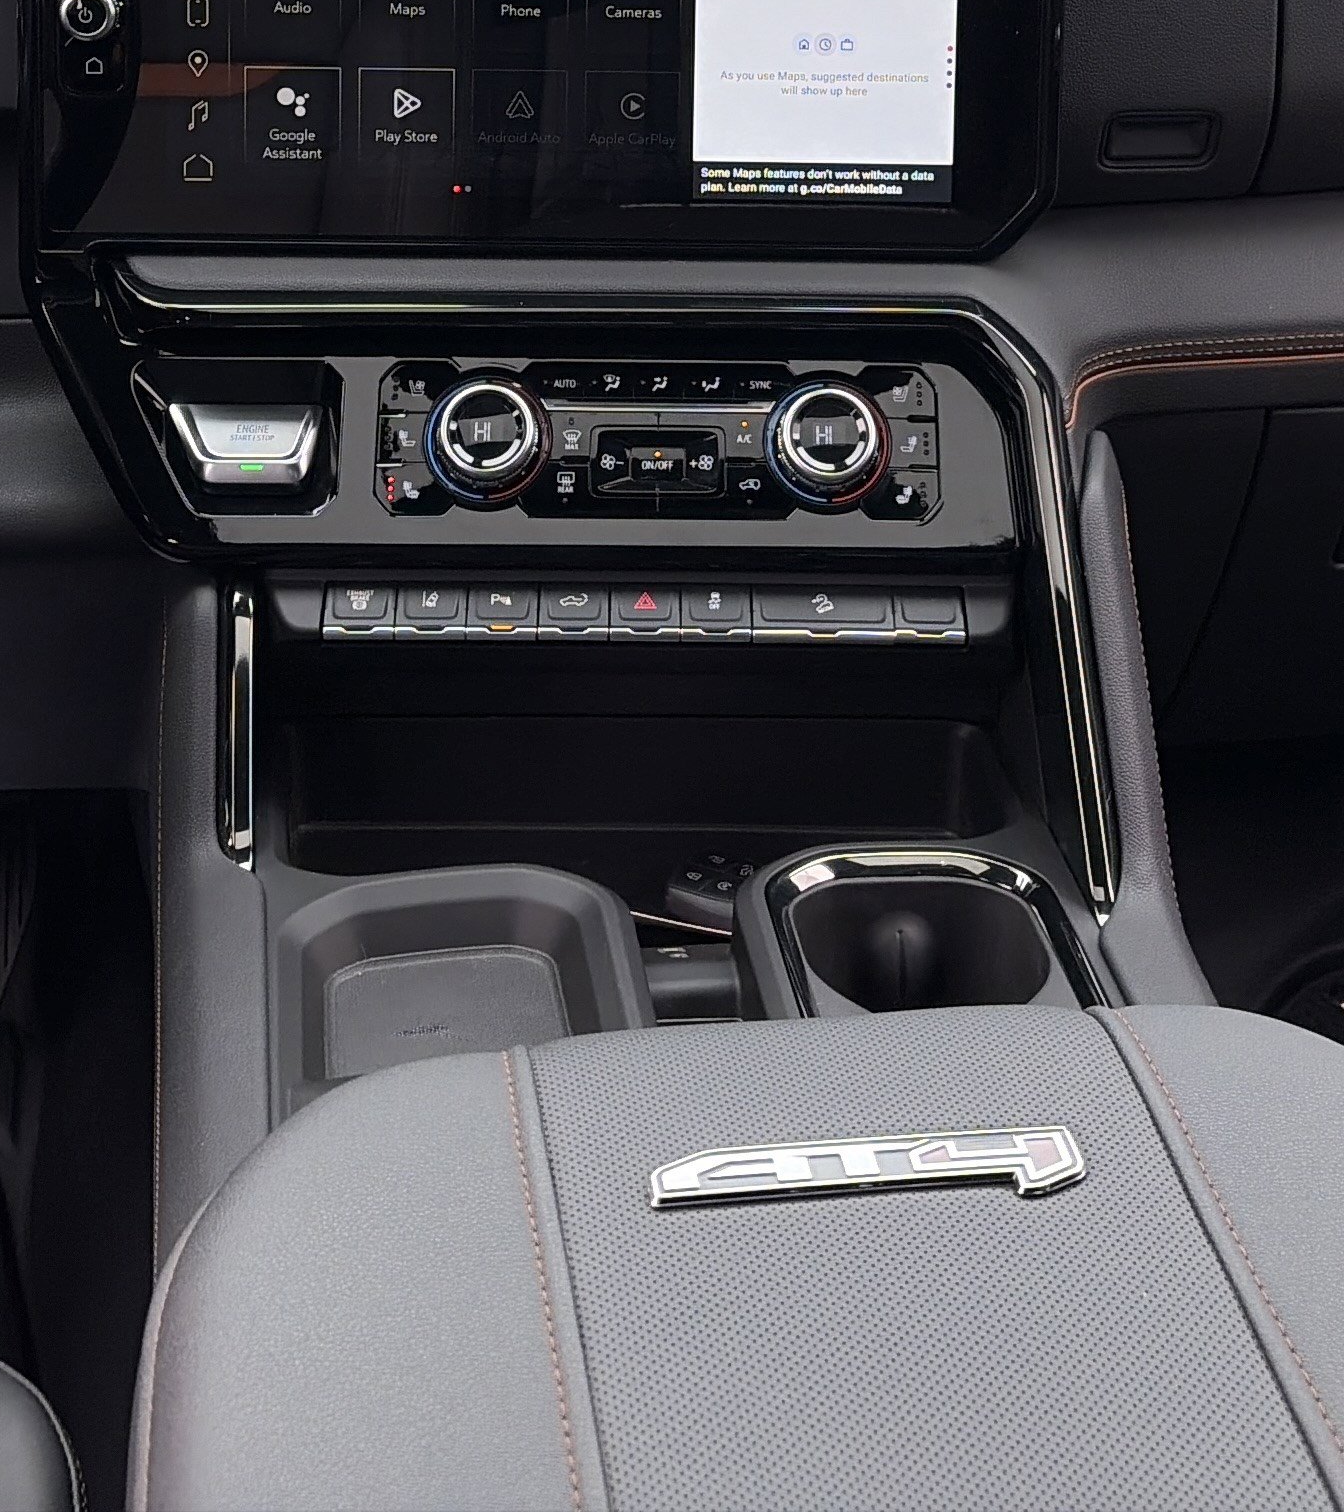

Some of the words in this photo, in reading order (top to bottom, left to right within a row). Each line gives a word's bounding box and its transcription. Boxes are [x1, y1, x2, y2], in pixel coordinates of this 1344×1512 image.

[274, 1, 311, 13] Audio
[390, 3, 425, 18] Maps
[501, 4, 541, 17] Phone
[606, 6, 662, 19] Cameras
[720, 71, 734, 80] As
[736, 73, 754, 82] you
[757, 73, 775, 81] use
[777, 72, 808, 83] Maps,
[811, 72, 864, 83] suggested
[867, 73, 929, 83] destinations
[781, 87, 798, 95] will
[801, 87, 827, 96] show
[830, 88, 843, 97] up
[845, 87, 868, 96] here
[269, 129, 316, 144] Google
[375, 130, 400, 145] Play
[404, 130, 437, 142] Store
[478, 131, 528, 143] Android
[530, 132, 560, 144] Auto
[589, 133, 624, 147] Apple
[628, 133, 676, 148] CarPlay
[263, 147, 322, 159] Assistant
[700, 167, 730, 178] Some
[733, 168, 761, 181] Maps
[764, 168, 805, 180] features
[807, 168, 833, 180] don't
[835, 169, 860, 180] work
[862, 170, 900, 181] without
[902, 172, 908, 180] a
[911, 171, 934, 181] data
[700, 182, 725, 193] plan.
[728, 182, 757, 192] Learn
[759, 184, 785, 193] more
[788, 183, 798, 193] at
[800, 183, 903, 195] g.co/CarMobileData
[554, 379, 576, 388] AUTO
[749, 380, 772, 390] SYNC
[236, 425, 270, 433] ENGINE
[474, 422, 491, 442] HI
[816, 425, 833, 445] HI
[737, 434, 752, 444] A/C
[641, 461, 674, 471] ON/OFF
[558, 484, 573, 493] REAR
[652, 1126, 1086, 1206] AT4
